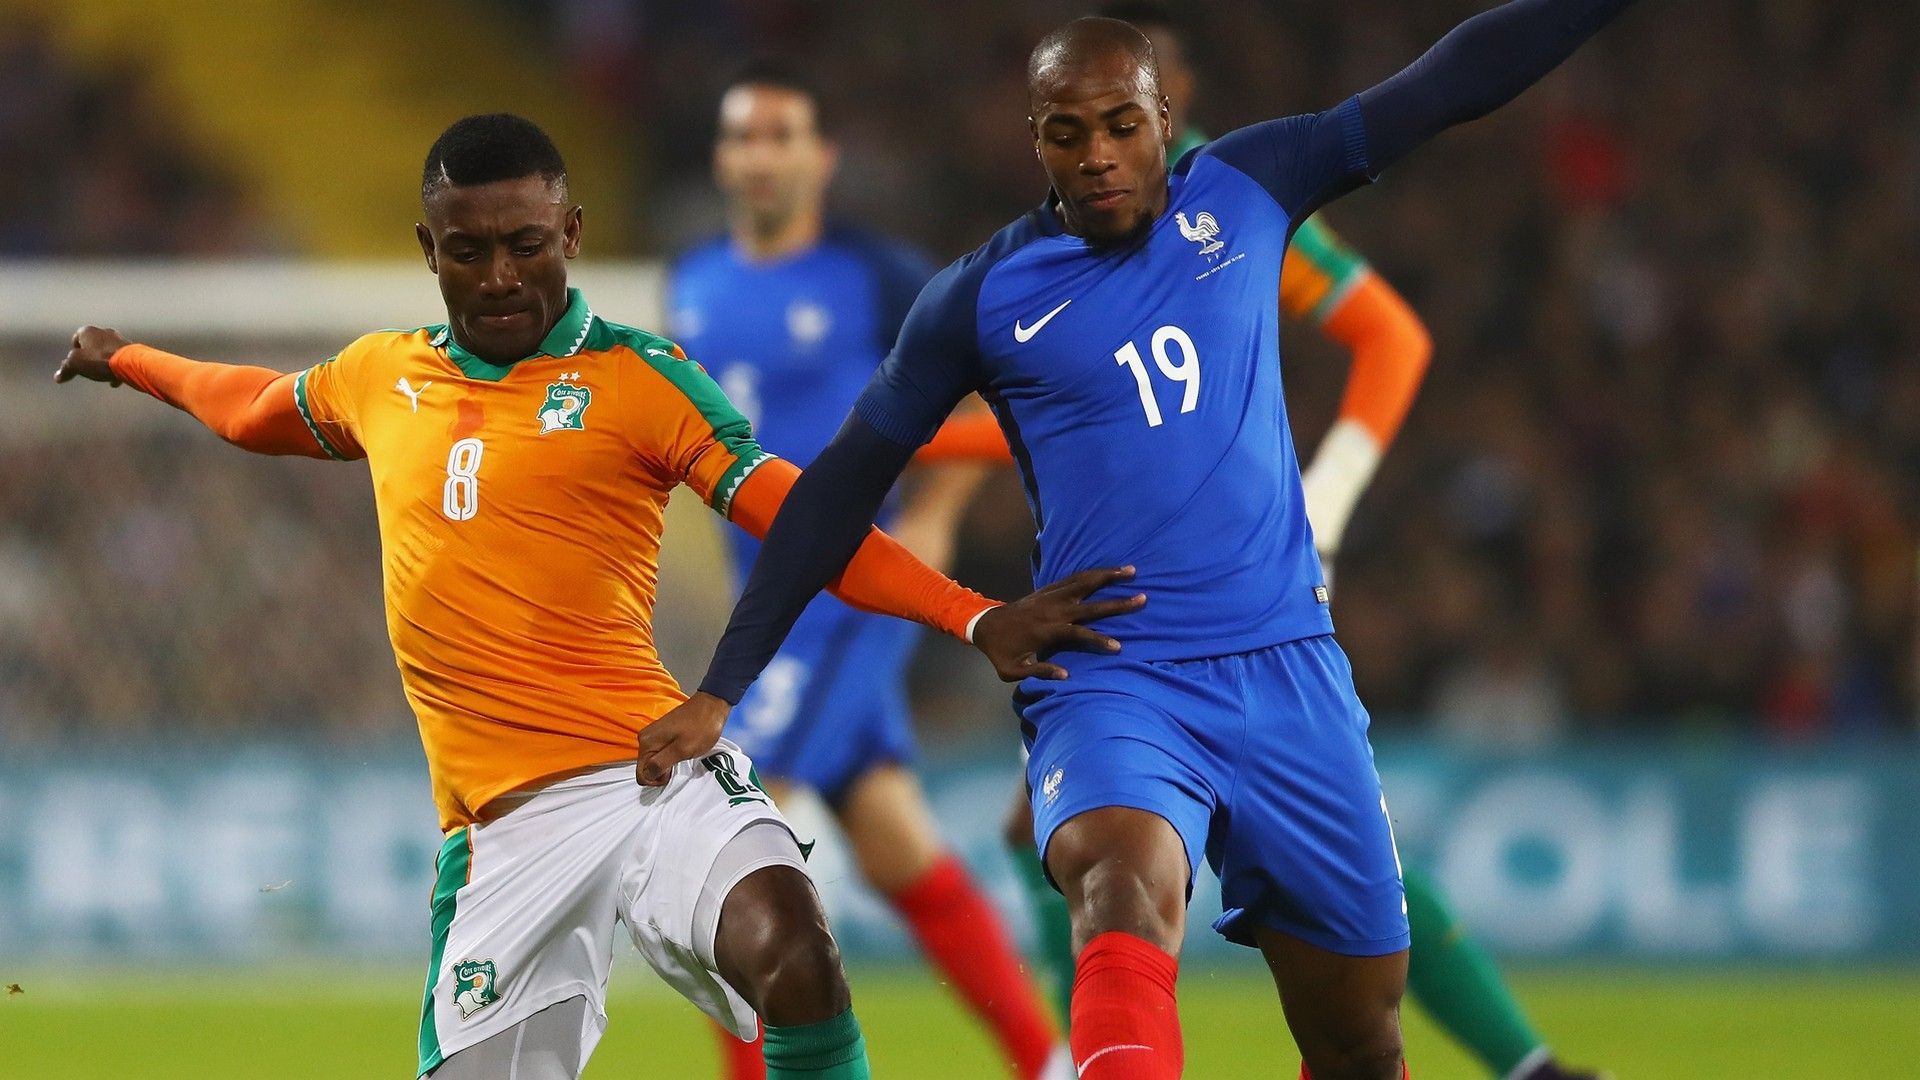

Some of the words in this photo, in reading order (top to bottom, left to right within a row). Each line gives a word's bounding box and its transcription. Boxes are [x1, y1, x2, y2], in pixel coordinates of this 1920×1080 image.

[1113, 325, 1201, 428] 19
[442, 437, 484, 521] 8
[1396, 772, 1877, 953] OLE
